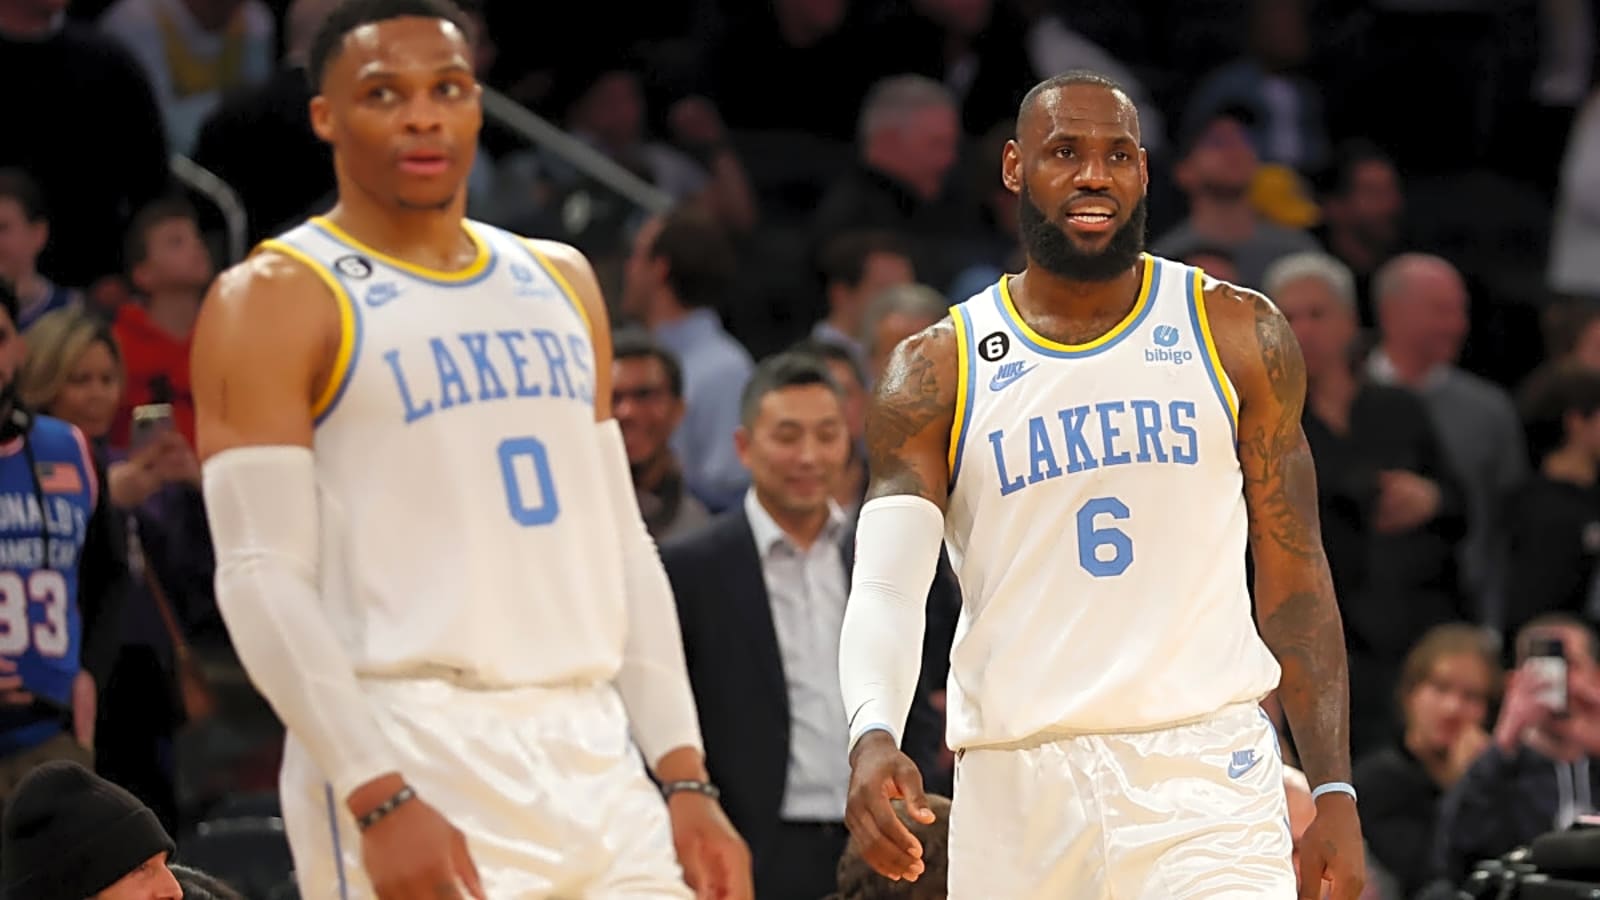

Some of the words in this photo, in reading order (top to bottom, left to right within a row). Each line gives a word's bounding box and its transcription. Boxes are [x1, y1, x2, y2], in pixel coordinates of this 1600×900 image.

[986, 335, 1004, 358] 6
[996, 360, 1026, 380] NIKE
[1144, 348, 1193, 365] bibigo
[384, 329, 593, 424] LAKERS
[988, 400, 1199, 496] LAKERS
[497, 435, 560, 527] 0
[1076, 497, 1134, 577] 6
[1232, 749, 1256, 767] NIKE
